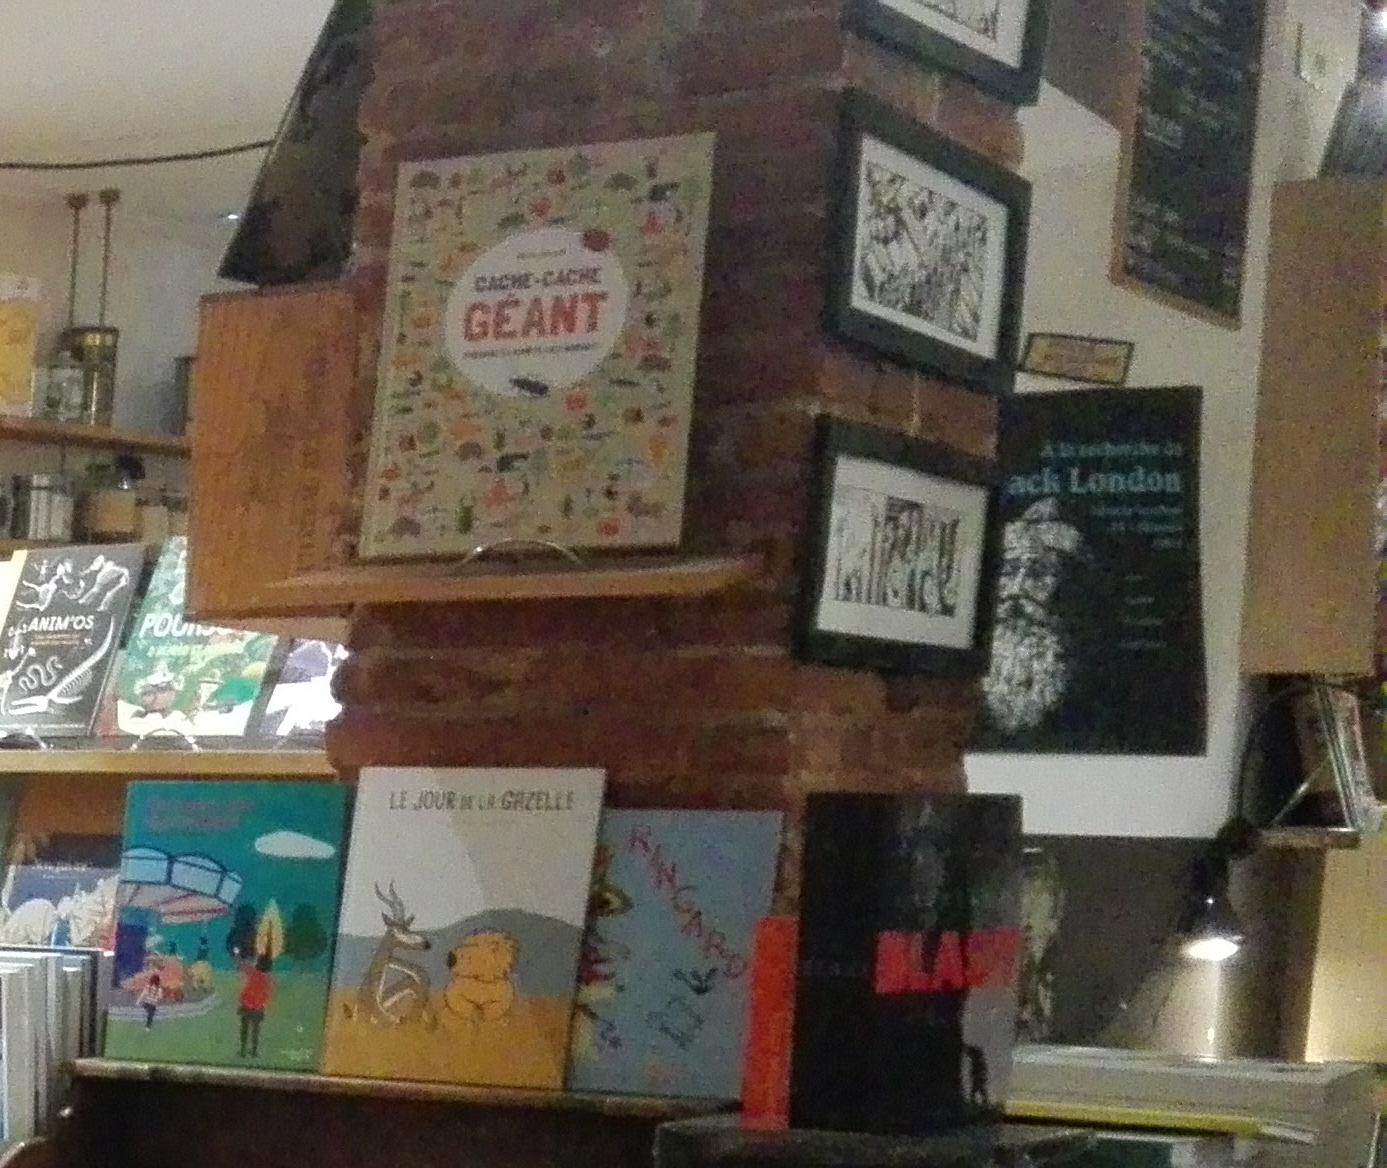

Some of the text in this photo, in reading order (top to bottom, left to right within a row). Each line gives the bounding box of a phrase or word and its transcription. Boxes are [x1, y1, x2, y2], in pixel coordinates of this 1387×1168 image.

[473, 267, 604, 293] CACHE-CACHE
[461, 291, 610, 342] GÉANT
[1005, 465, 1181, 495] ack London
[27, 614, 96, 633] ANIM'OS
[412, 788, 456, 812] JOUR
[499, 788, 577, 813] GAZELLE
